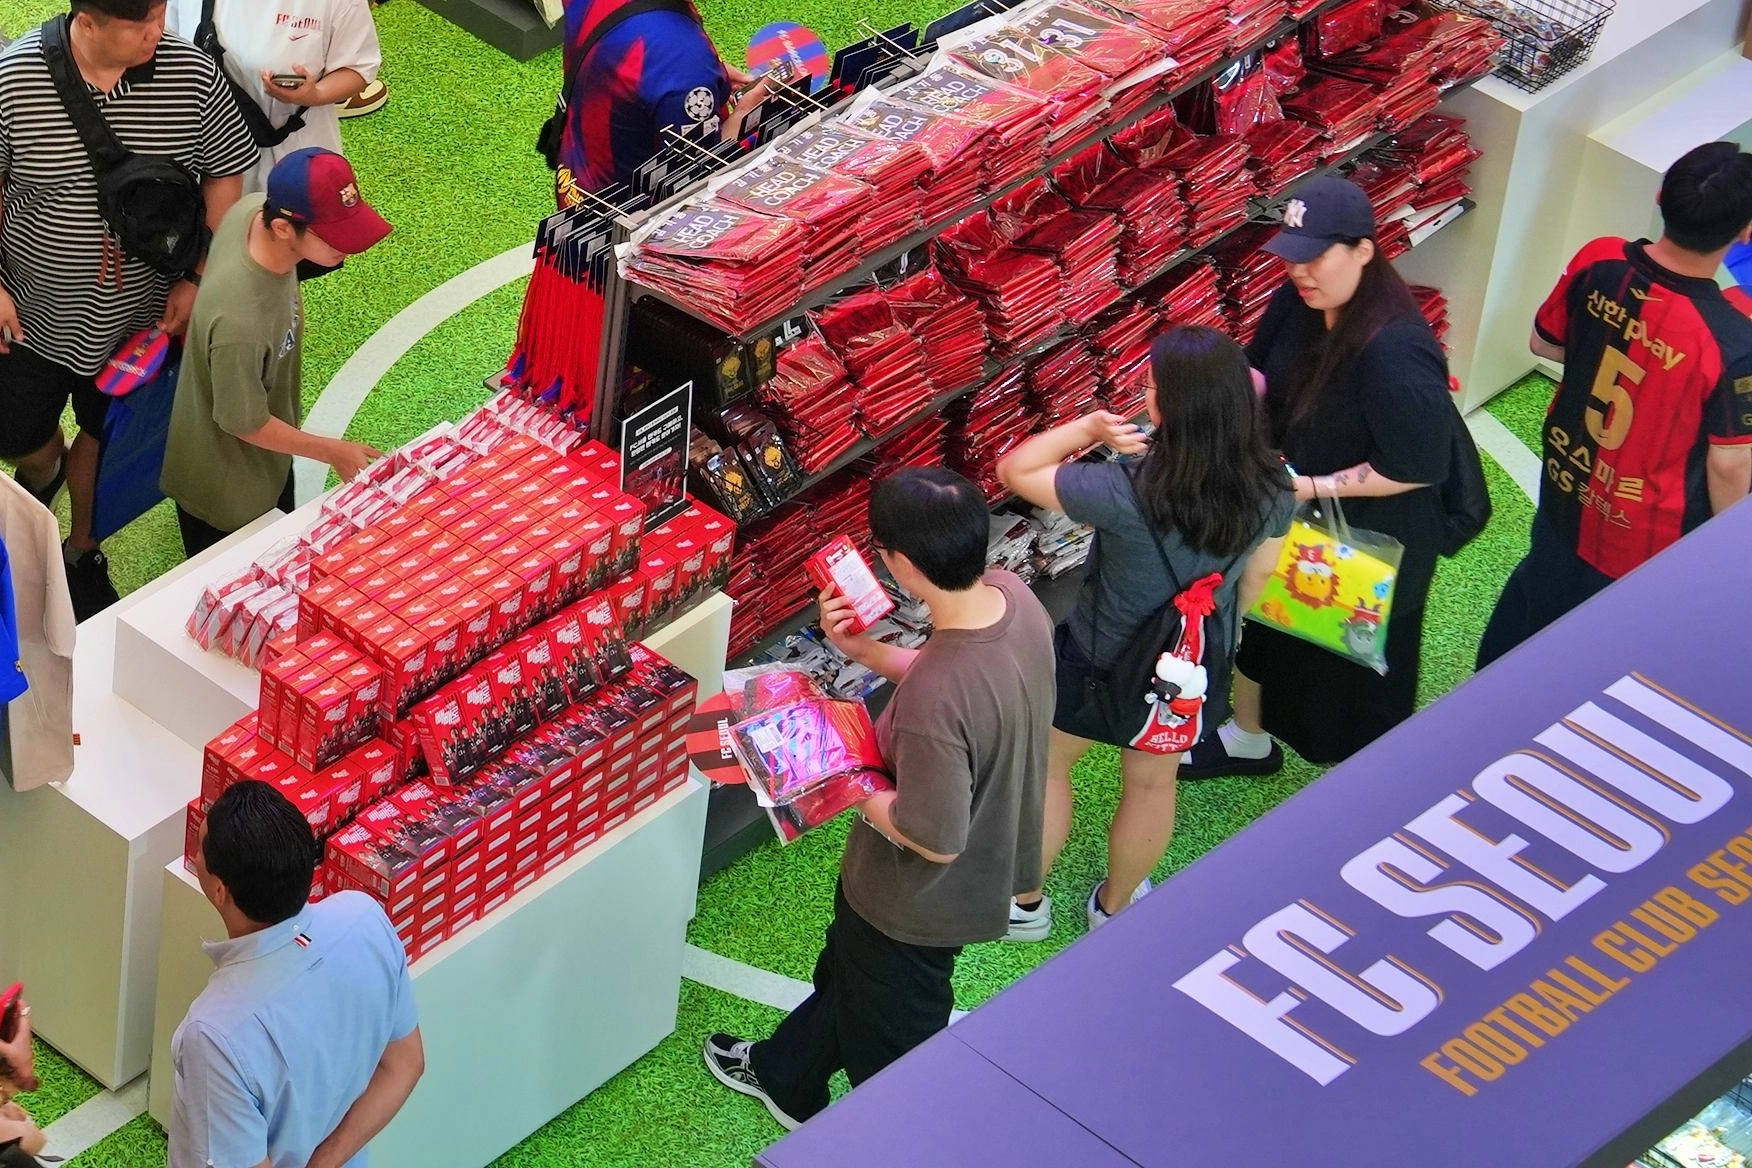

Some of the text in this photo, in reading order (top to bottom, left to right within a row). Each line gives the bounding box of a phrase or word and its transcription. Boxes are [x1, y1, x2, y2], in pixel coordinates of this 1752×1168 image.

[1040, 18, 1097, 49] 31
[874, 114, 903, 138] EAD
[751, 171, 795, 198] HEAD
[764, 172, 821, 206] COACH
[672, 214, 715, 244] HEAD
[689, 214, 739, 249] COACH
[1584, 344, 1647, 451] 5
[1547, 457, 1574, 494] GS
[1549, 424, 1644, 503] 오스마르
[717, 717, 733, 761] FC SEOUL
[1171, 899, 1443, 1088] FC
[1420, 954, 1632, 1096] FOOTBALL
[1591, 885, 1721, 970] CLUB
